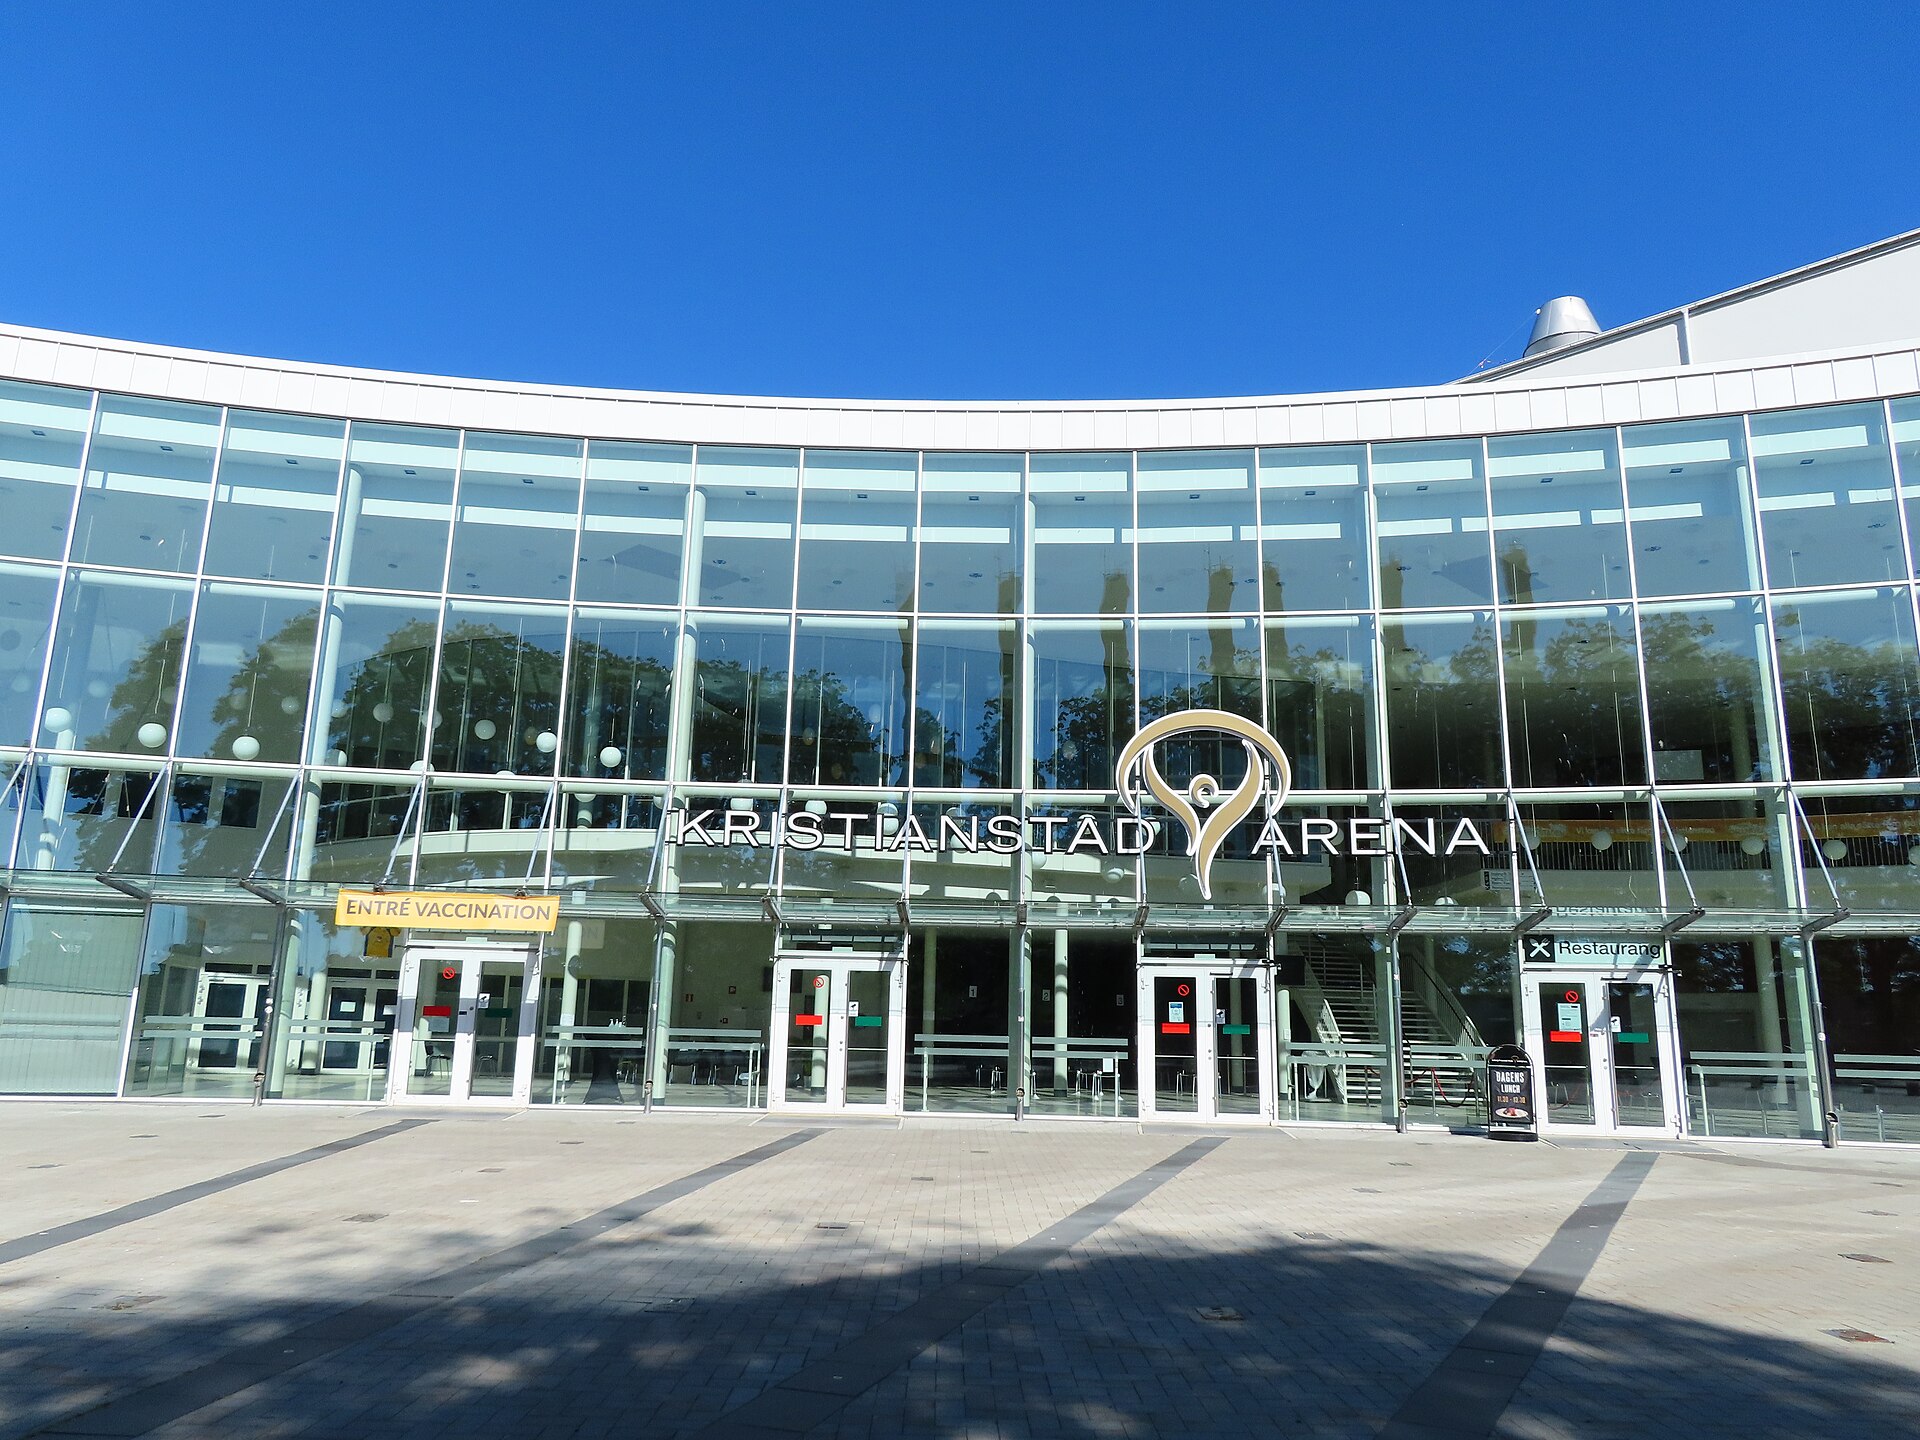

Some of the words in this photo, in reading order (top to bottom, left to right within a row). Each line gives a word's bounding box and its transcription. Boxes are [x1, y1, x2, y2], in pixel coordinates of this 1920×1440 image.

[676, 808, 1156, 854] KRISTIANSTAD
[1251, 817, 1491, 856] ARENA
[346, 898, 411, 917] ENTRÉ
[415, 901, 552, 921] VACCINATION
[1559, 941, 1661, 959] Restaurang
[1496, 1071, 1525, 1083] DAGENS
[1501, 1084, 1521, 1094] LUNCH
